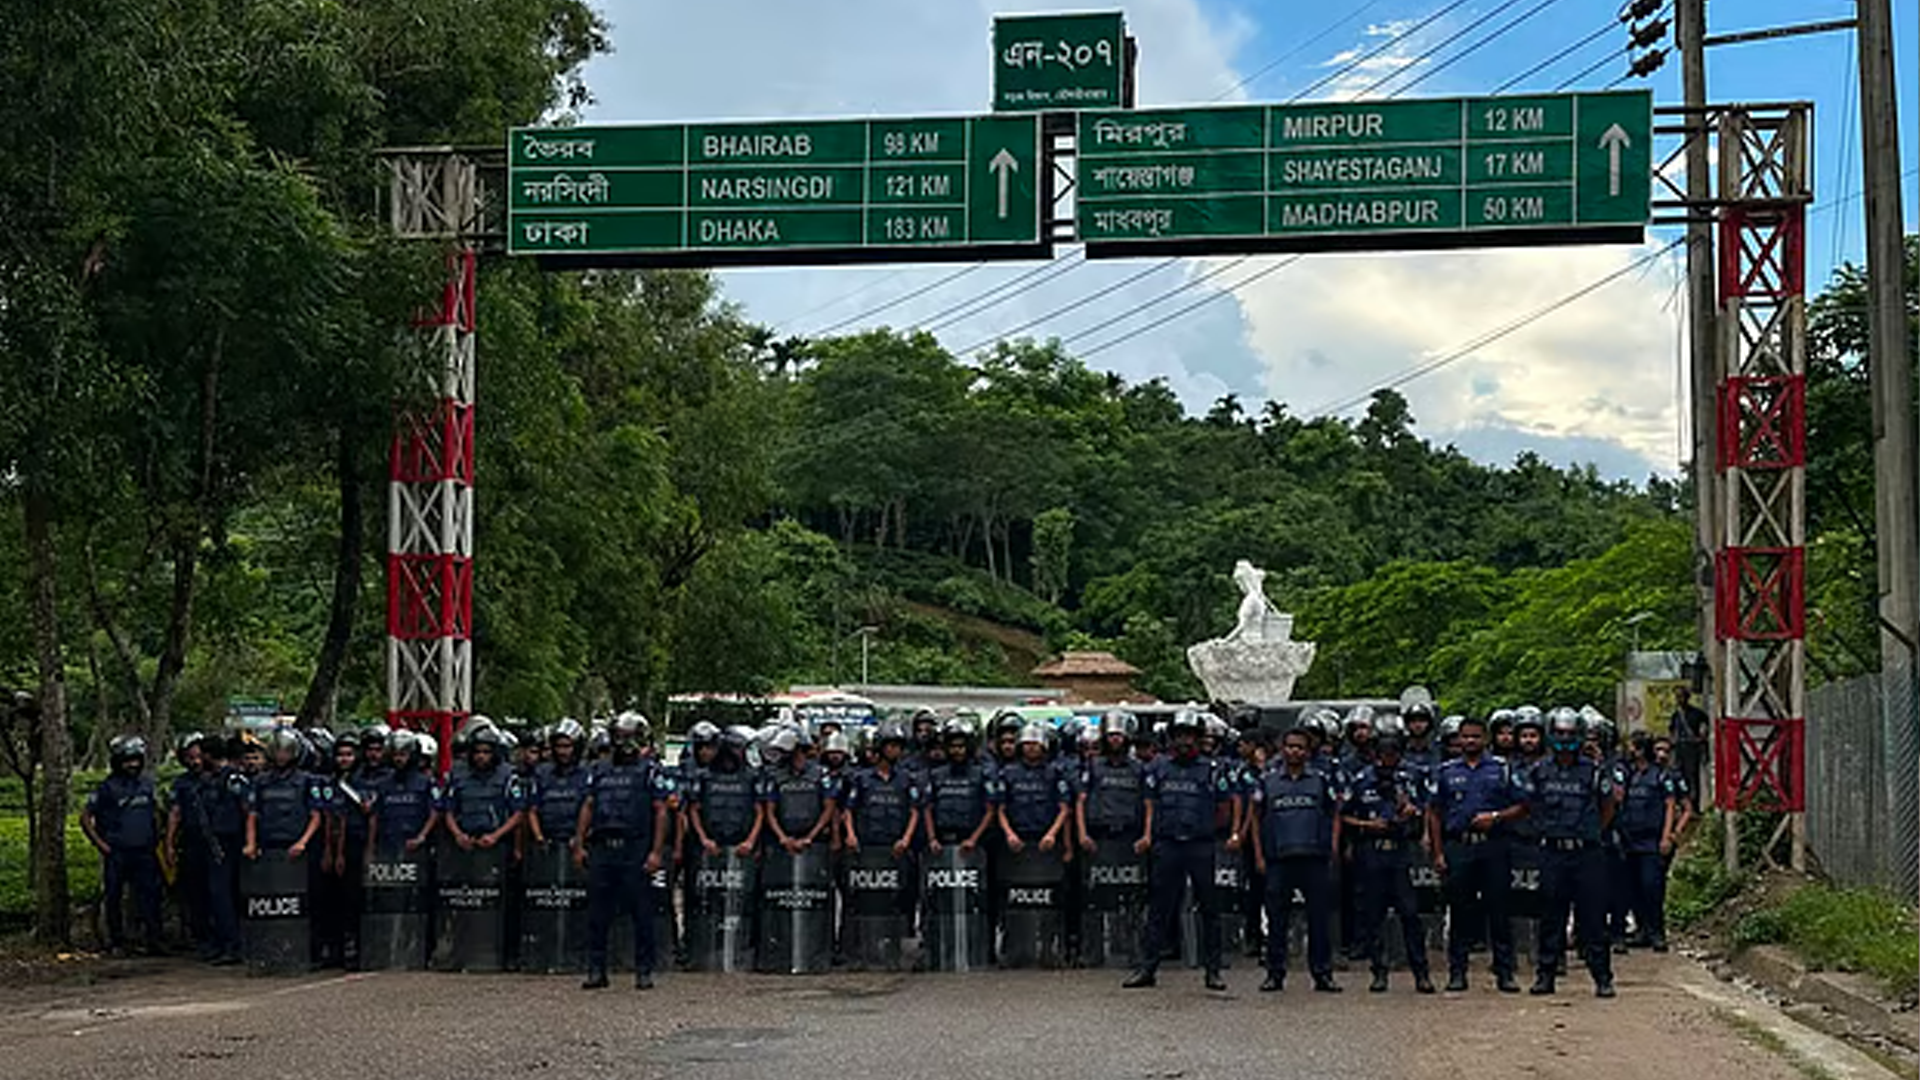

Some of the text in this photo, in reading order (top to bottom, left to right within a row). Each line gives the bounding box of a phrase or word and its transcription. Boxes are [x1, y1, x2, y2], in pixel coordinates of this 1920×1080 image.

[1003, 38, 1113, 72] এন-২০৭
[1283, 113, 1384, 138] MIRPUR
[1484, 107, 1545, 132] 12 KM
[703, 133, 812, 158] BHAIRAB
[883, 131, 940, 156] 98 KM
[1091, 118, 1188, 149] মিরপুর
[522, 134, 596, 159] ভৈরব
[1283, 156, 1442, 183] SHAYESTAGANJ
[1484, 152, 1545, 176] 17 KM
[701, 175, 833, 200] NARSINGDI
[886, 174, 950, 197] 121 KM
[1282, 200, 1439, 226] MADHABPUR
[1483, 196, 1545, 221] 50 KM
[522, 220, 590, 246] ঢাকা
[700, 217, 780, 242] DHAKA
[884, 215, 950, 240] 183 KM
[1093, 209, 1175, 237] মাধবপুর
[368, 863, 418, 881] POLICE
[696, 869, 745, 888] POLICE
[851, 869, 899, 888] POLICE
[927, 869, 979, 888] POLICE
[1089, 866, 1141, 884] POLICE
[1213, 868, 1239, 887] ICE
[248, 896, 301, 917] POLICE
[1008, 887, 1052, 905] POLICE
